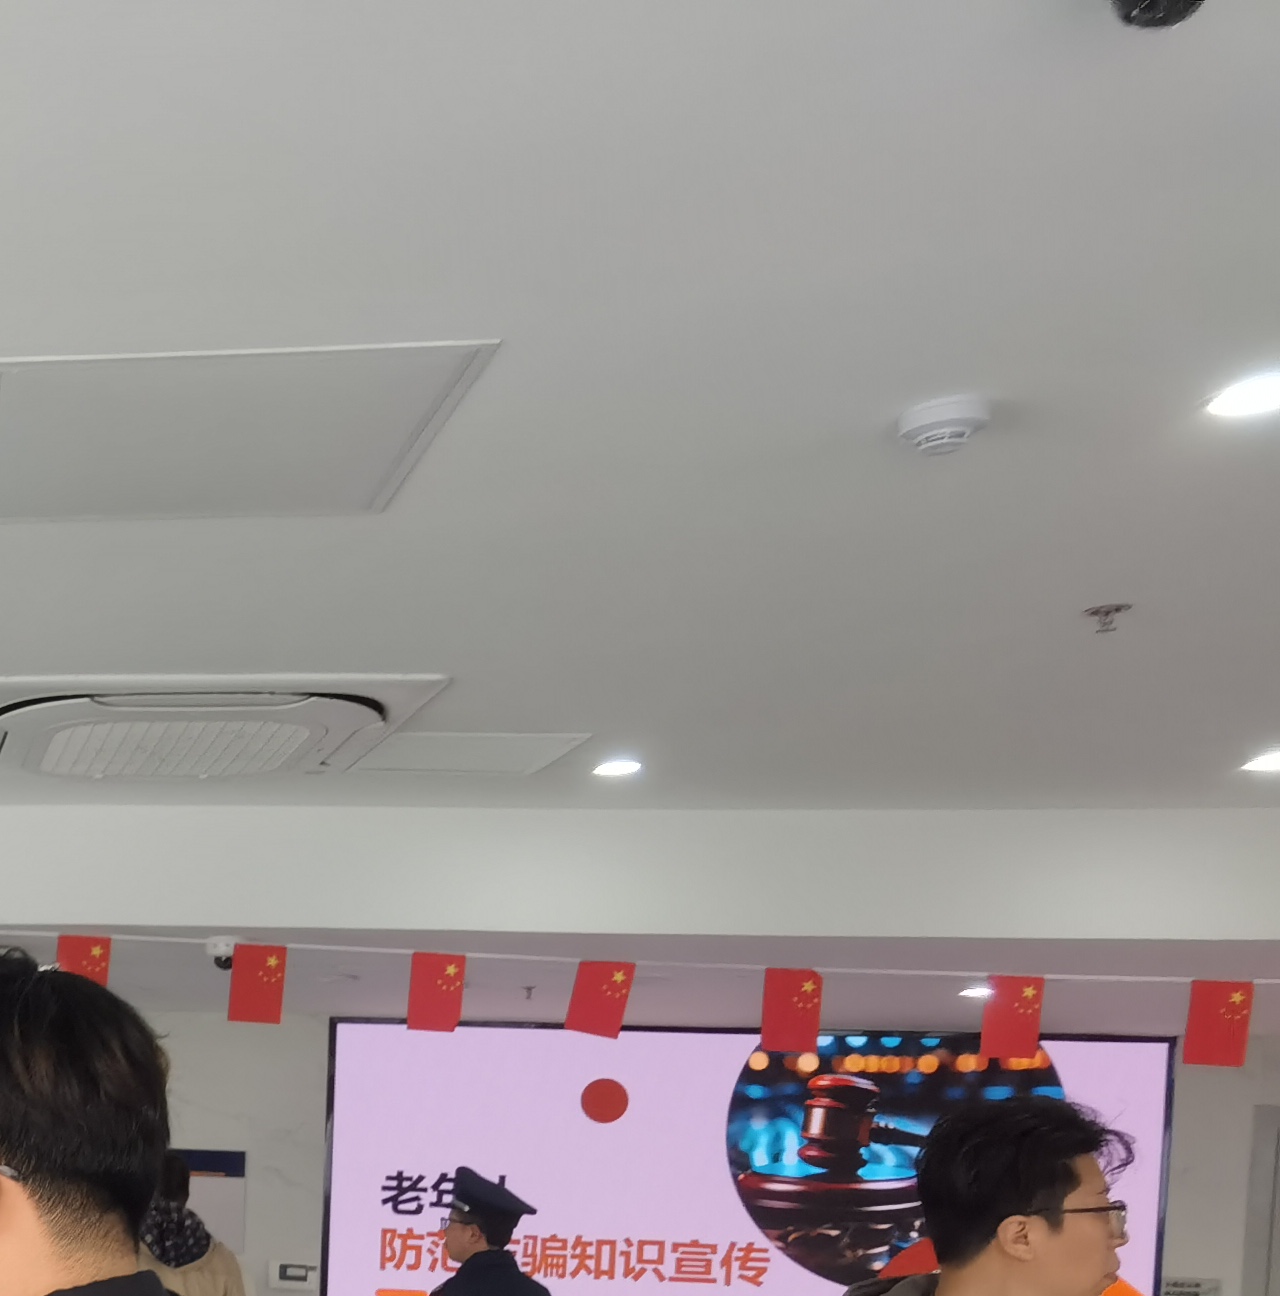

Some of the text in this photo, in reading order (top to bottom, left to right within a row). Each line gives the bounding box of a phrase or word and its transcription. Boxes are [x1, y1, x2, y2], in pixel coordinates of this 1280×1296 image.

[379, 1227, 772, 1288] 防范骗知识宣传
